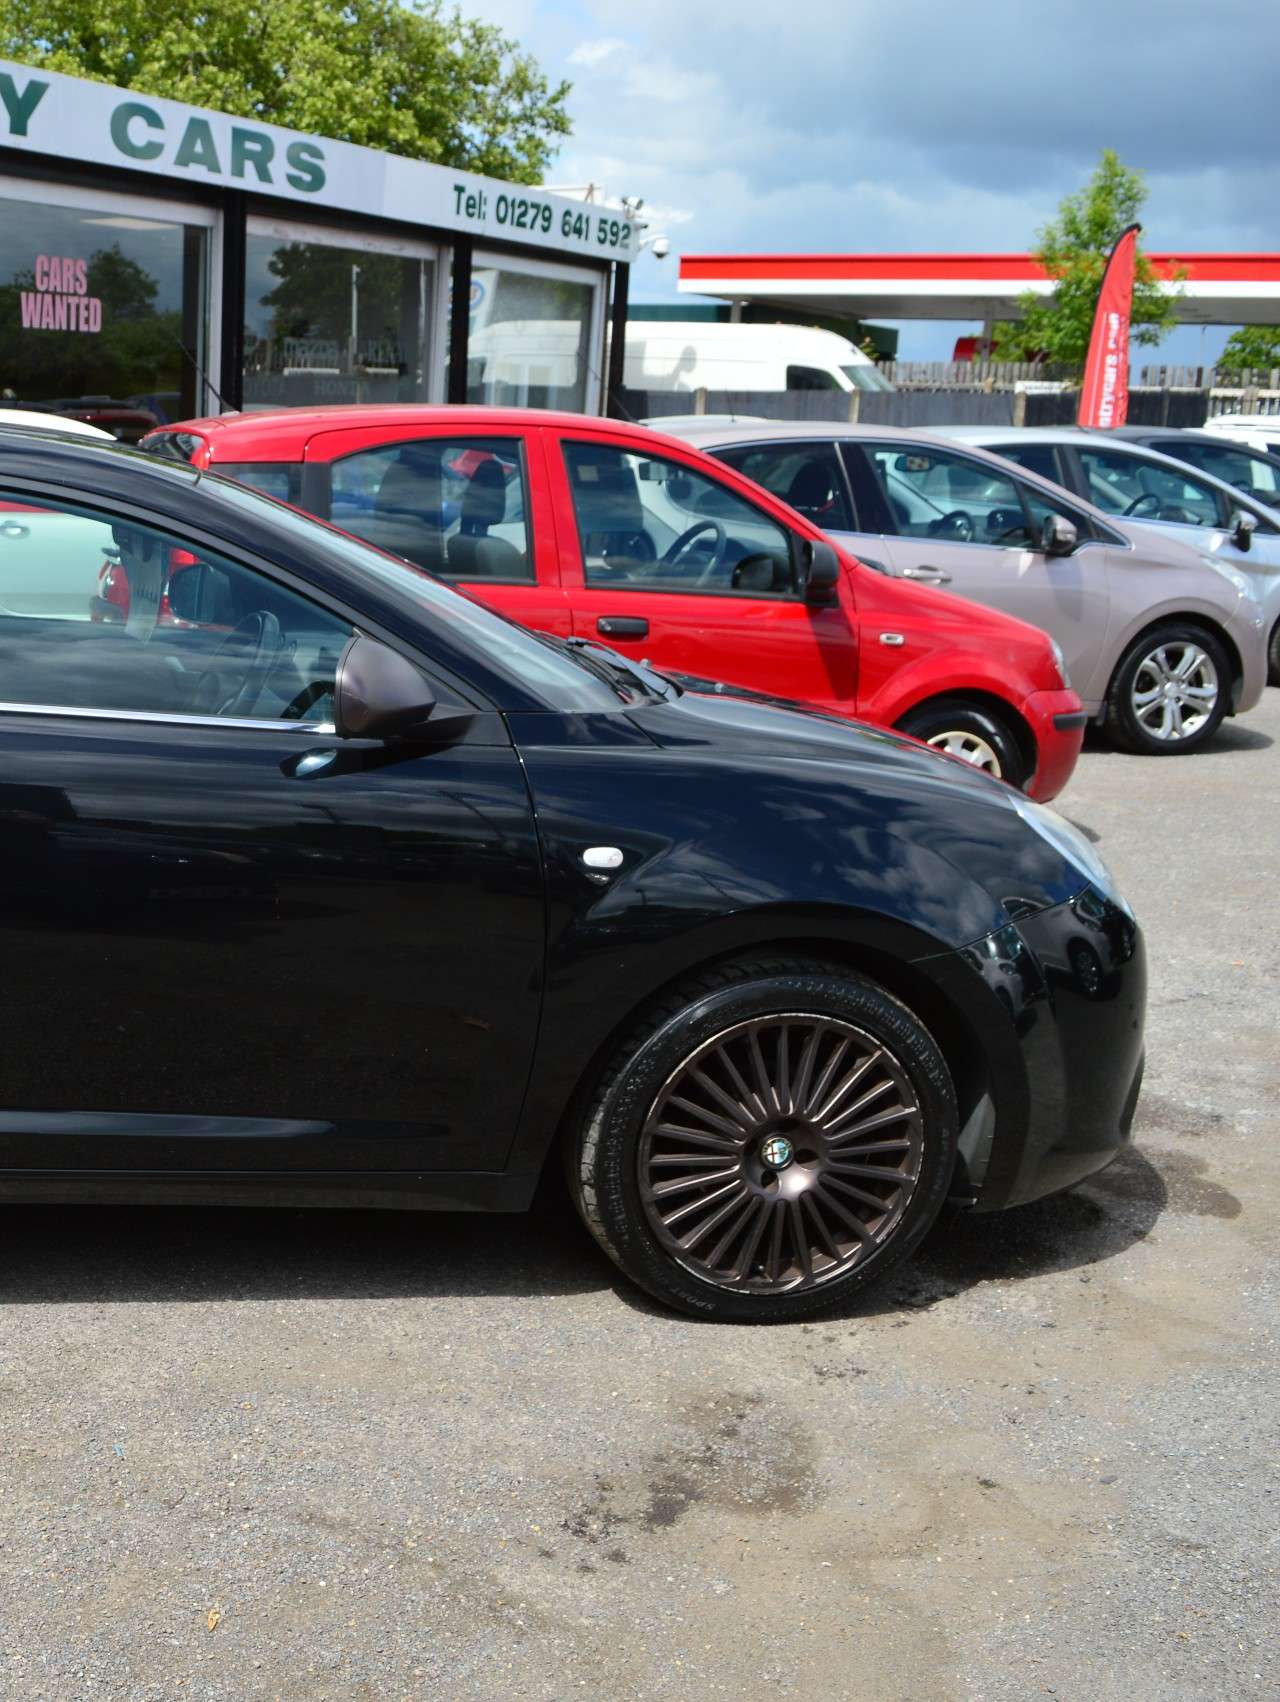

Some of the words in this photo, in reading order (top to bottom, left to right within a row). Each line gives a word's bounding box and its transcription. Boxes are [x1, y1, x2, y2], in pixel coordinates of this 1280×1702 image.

[110, 101, 327, 193] CARS
[453, 184, 488, 220] Tel:
[495, 194, 553, 233] 01279
[561, 210, 591, 241] 641
[596, 218, 632, 249] 592
[35, 254, 88, 295] CARS
[20, 291, 102, 334] WANTED
